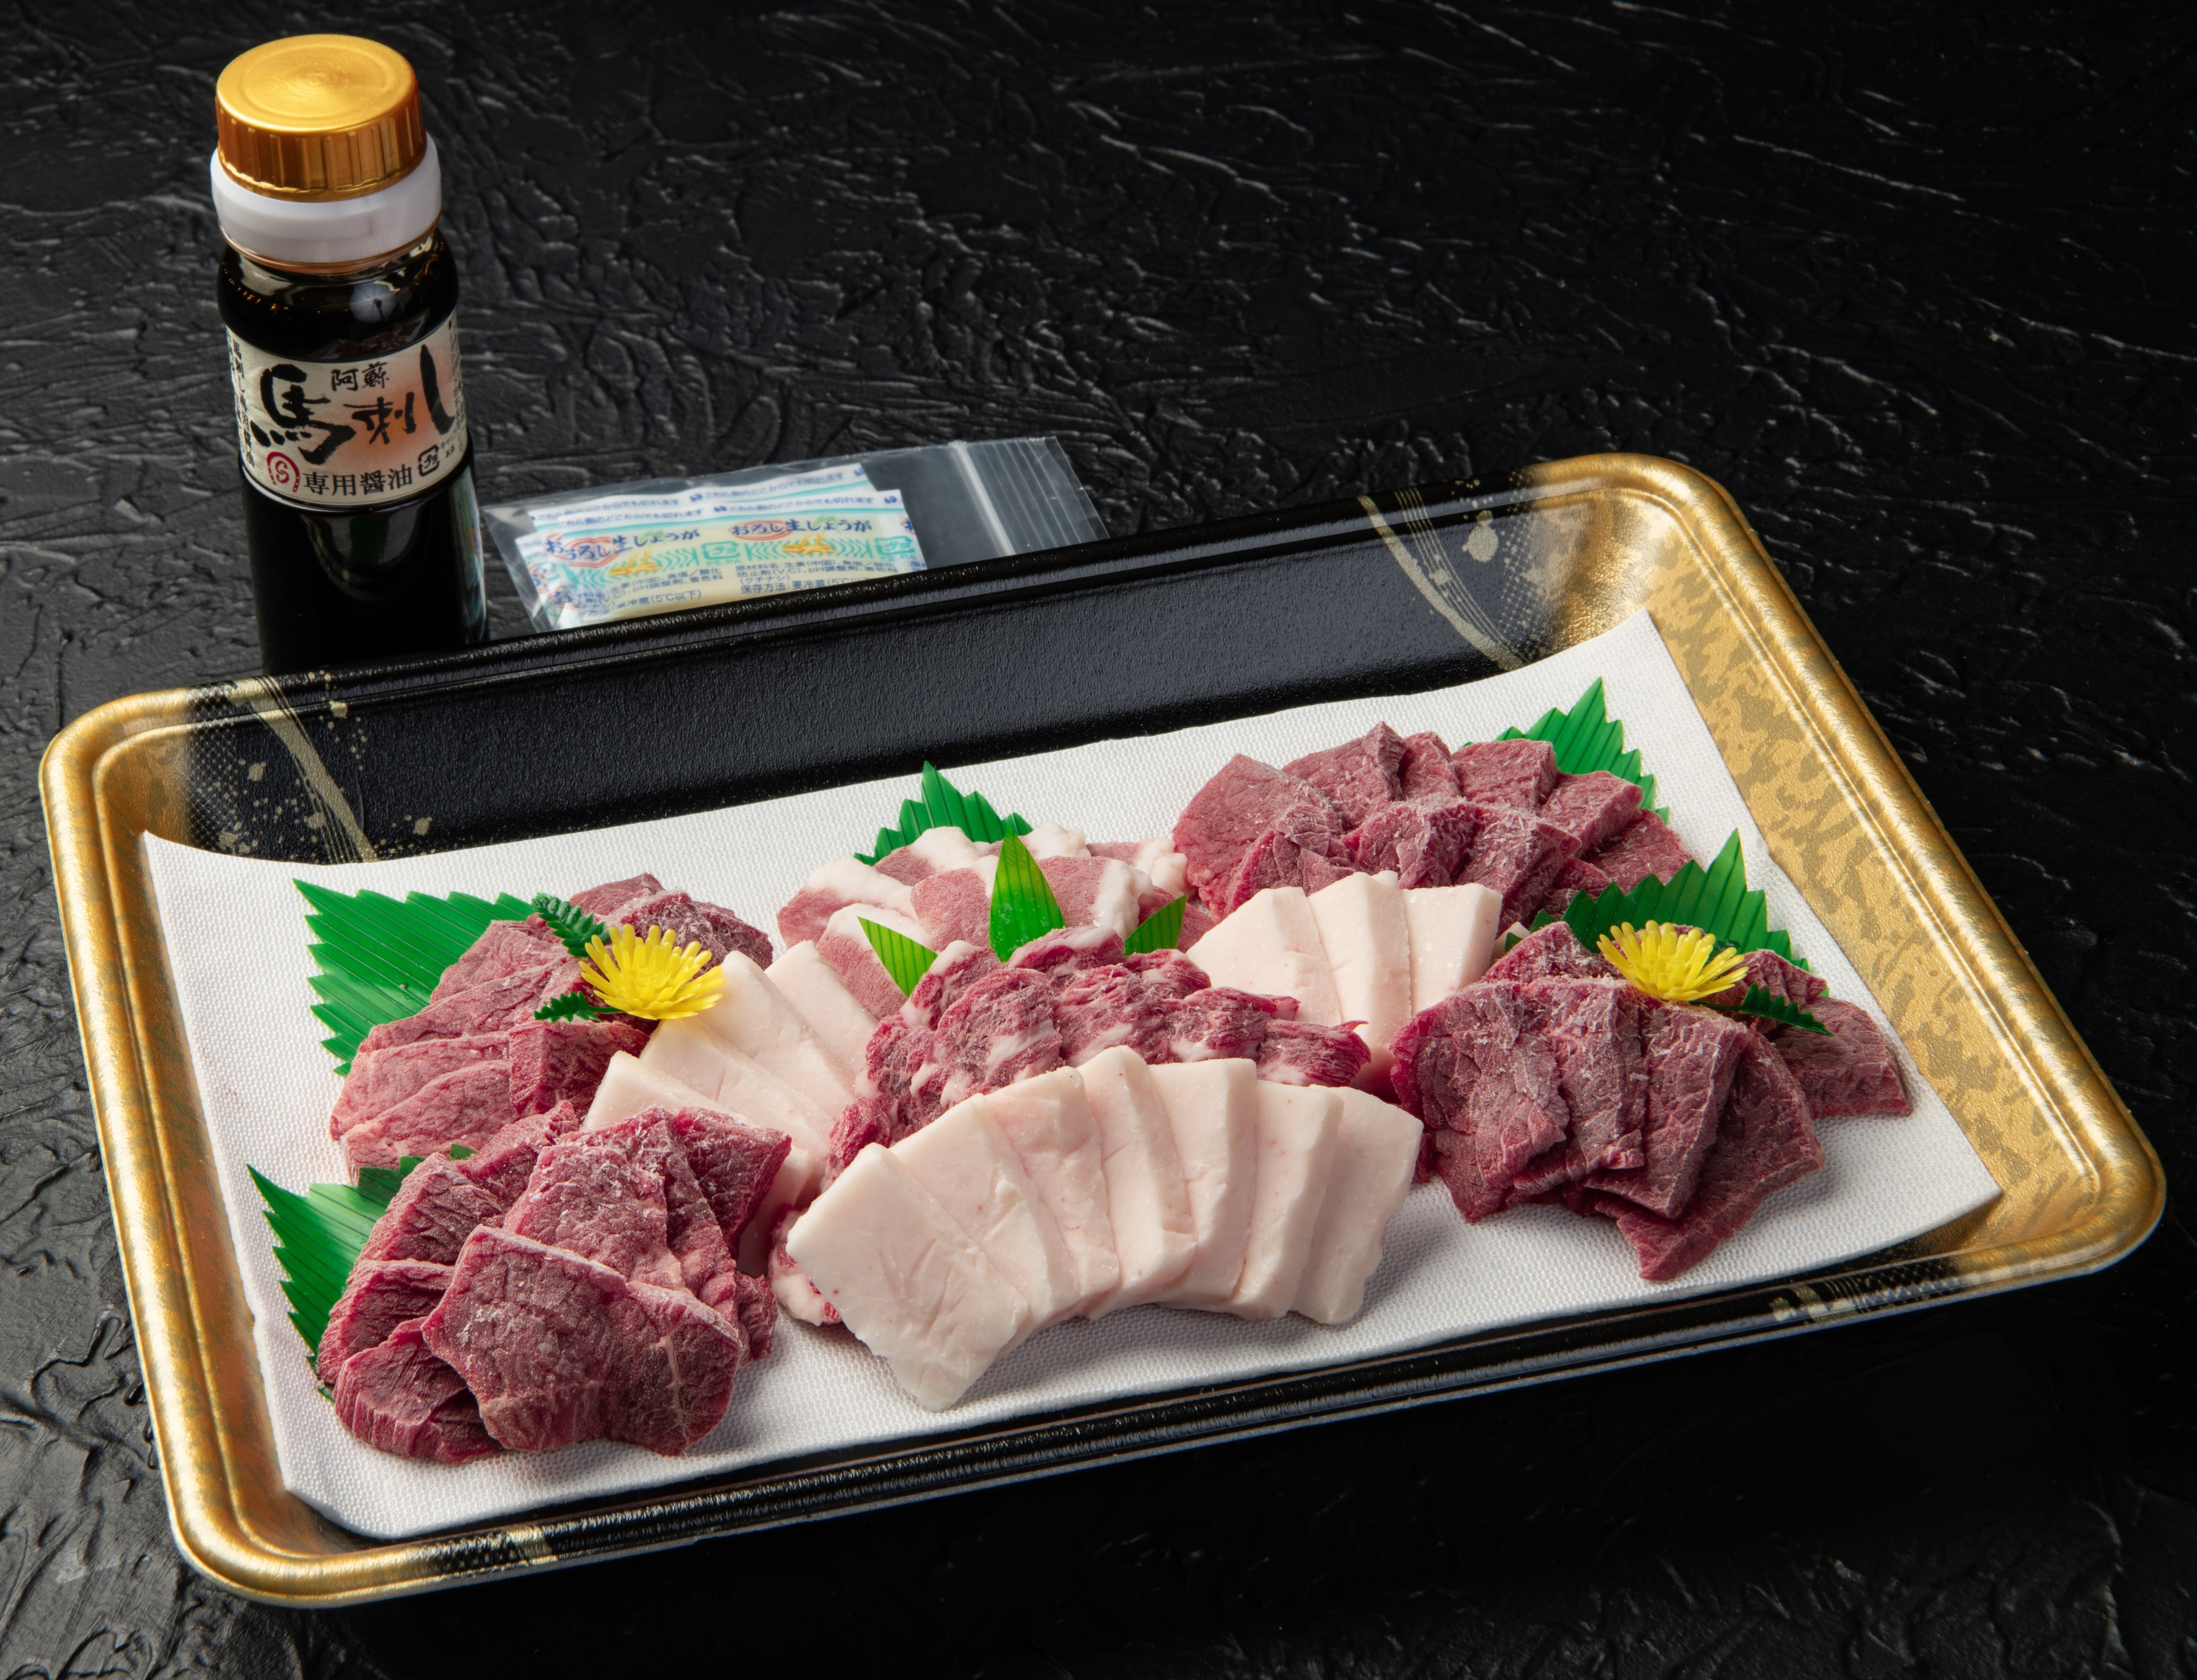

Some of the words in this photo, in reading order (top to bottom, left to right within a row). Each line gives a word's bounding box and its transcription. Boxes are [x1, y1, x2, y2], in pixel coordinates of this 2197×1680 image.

[250, 344, 455, 465] 馬刺し
[303, 464, 412, 496] 専用醤油
[732, 518, 873, 536] おろし生しょうが
